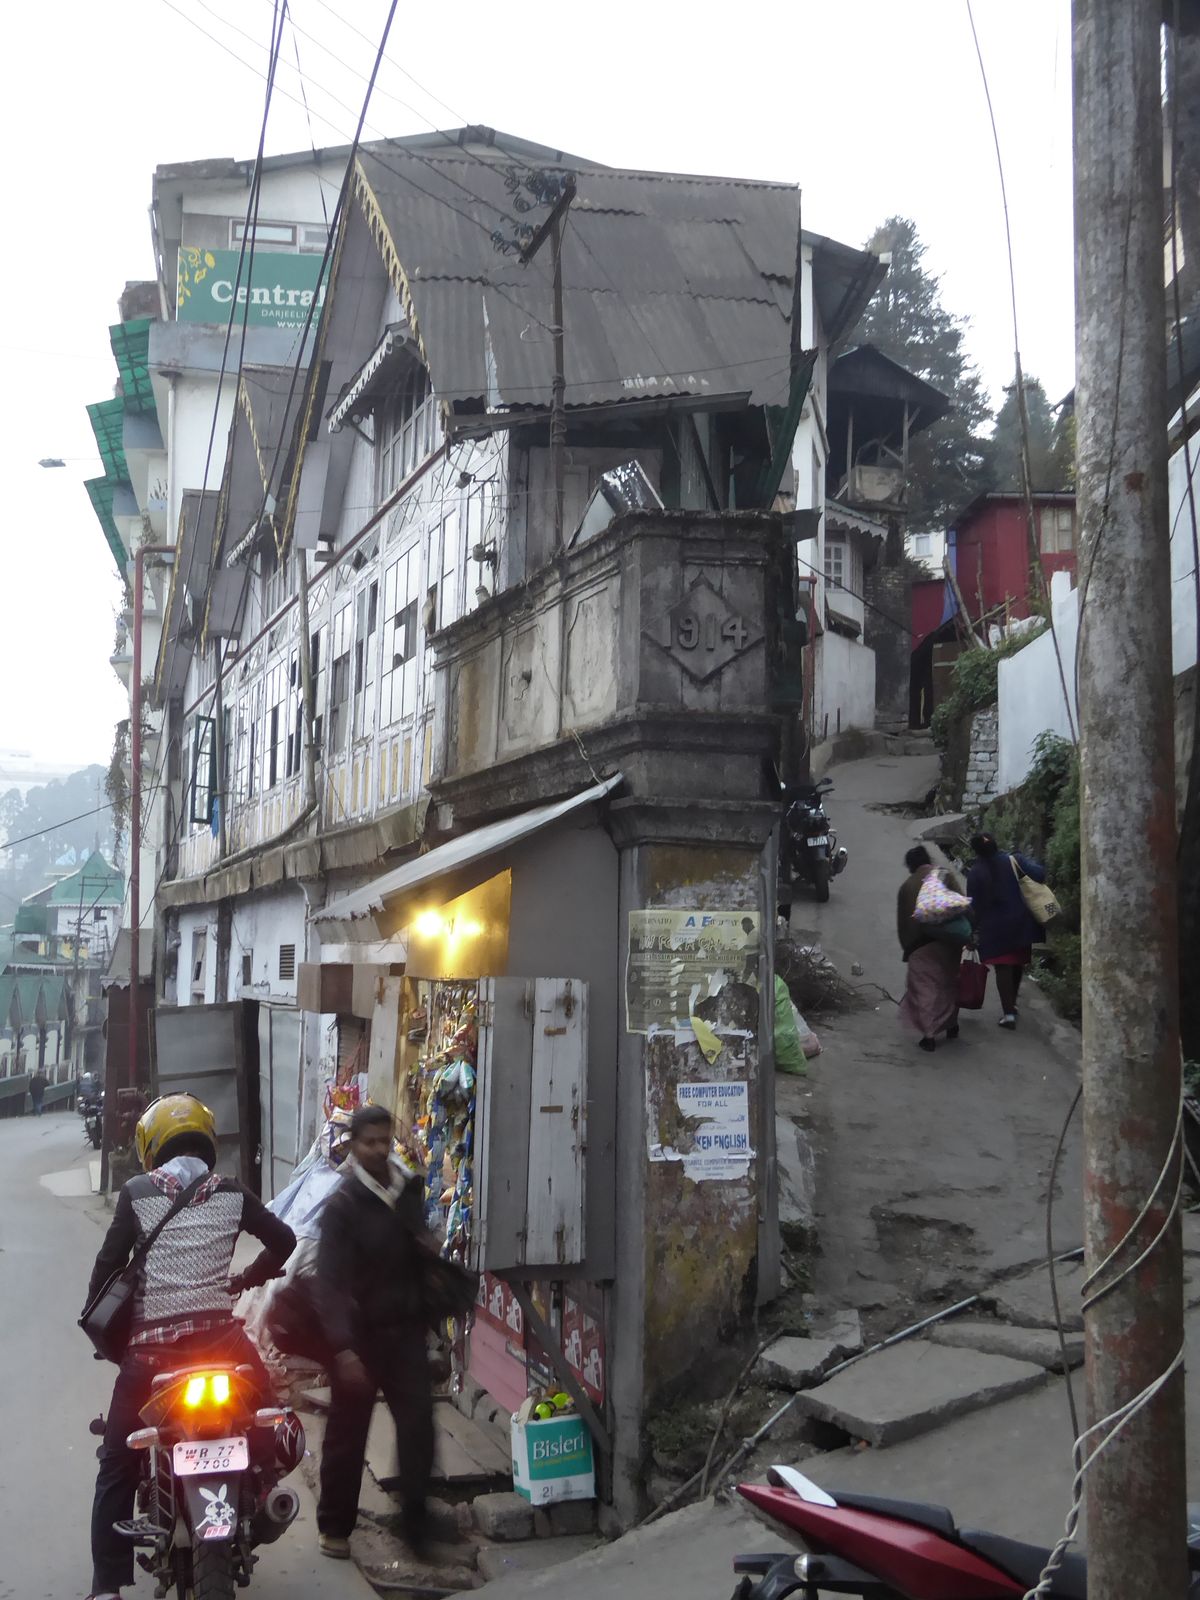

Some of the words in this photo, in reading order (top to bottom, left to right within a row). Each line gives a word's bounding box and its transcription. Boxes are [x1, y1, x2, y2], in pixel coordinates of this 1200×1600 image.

[211, 280, 326, 308] Central
[663, 614, 748, 651] 1914
[679, 1087, 692, 1098] FREE
[692, 1086, 718, 1098] COMPUTER
[718, 1085, 745, 1098] EDUCATION
[714, 1100, 729, 1108] ALL
[218, 1446, 235, 1457] 77
[533, 1432, 584, 1460] Bisleri
[193, 1458, 230, 1471] 7700
